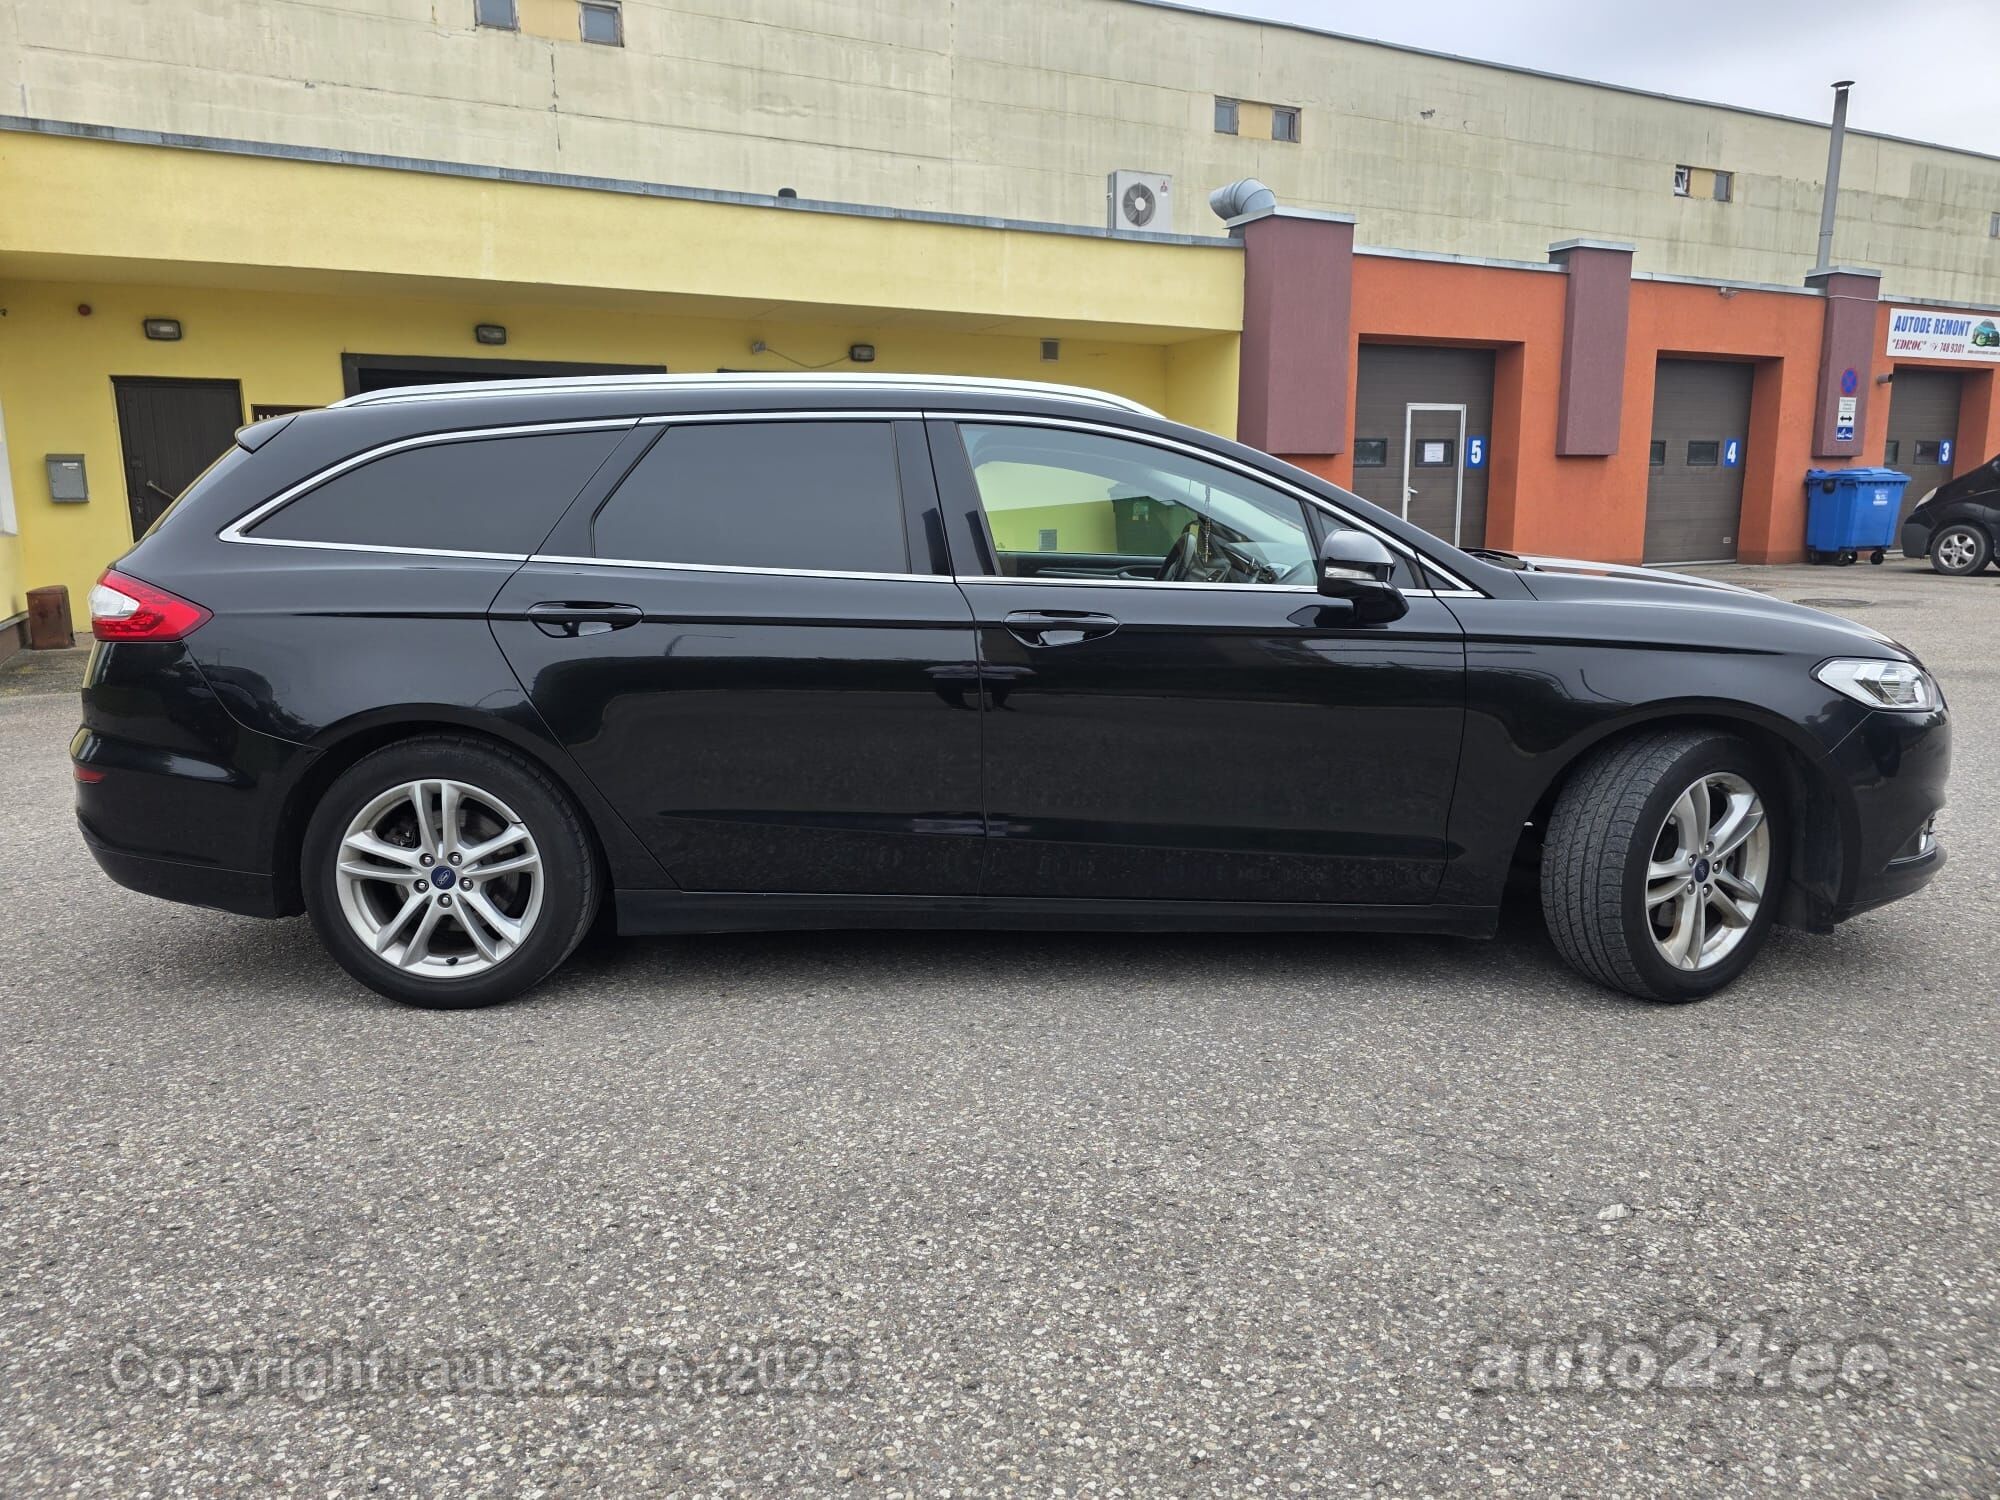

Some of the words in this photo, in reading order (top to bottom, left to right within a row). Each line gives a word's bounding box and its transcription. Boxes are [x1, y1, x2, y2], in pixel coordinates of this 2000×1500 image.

[1894, 315, 1932, 334] AUTODE
[1933, 318, 1972, 337] REMONT
[1470, 439, 1482, 464] 5
[1727, 441, 1737, 463] 4
[1942, 442, 1950, 462] 3
